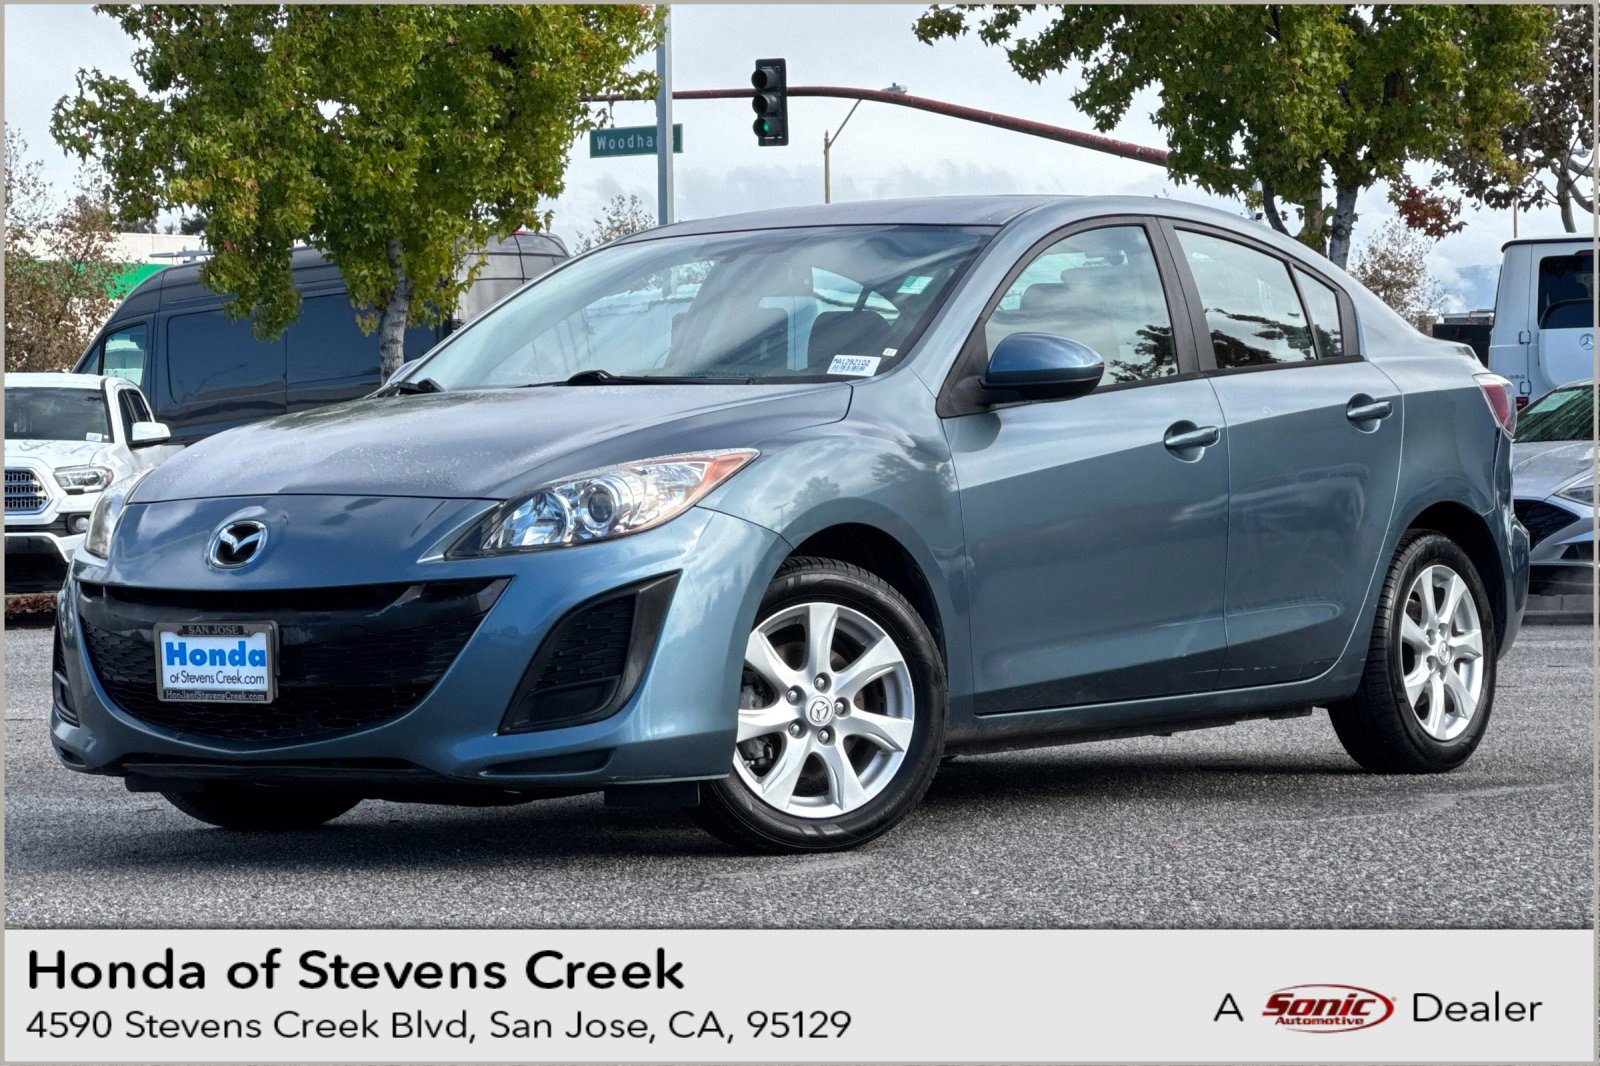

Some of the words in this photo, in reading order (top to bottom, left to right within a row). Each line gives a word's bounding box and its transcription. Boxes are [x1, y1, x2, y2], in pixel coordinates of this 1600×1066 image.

[188, 626, 209, 635] SAN
[211, 626, 239, 635] JOSE
[165, 641, 267, 667] Honda
[170, 671, 180, 684] of
[181, 670, 215, 684] Stevens
[216, 670, 265, 685] Creek.com
